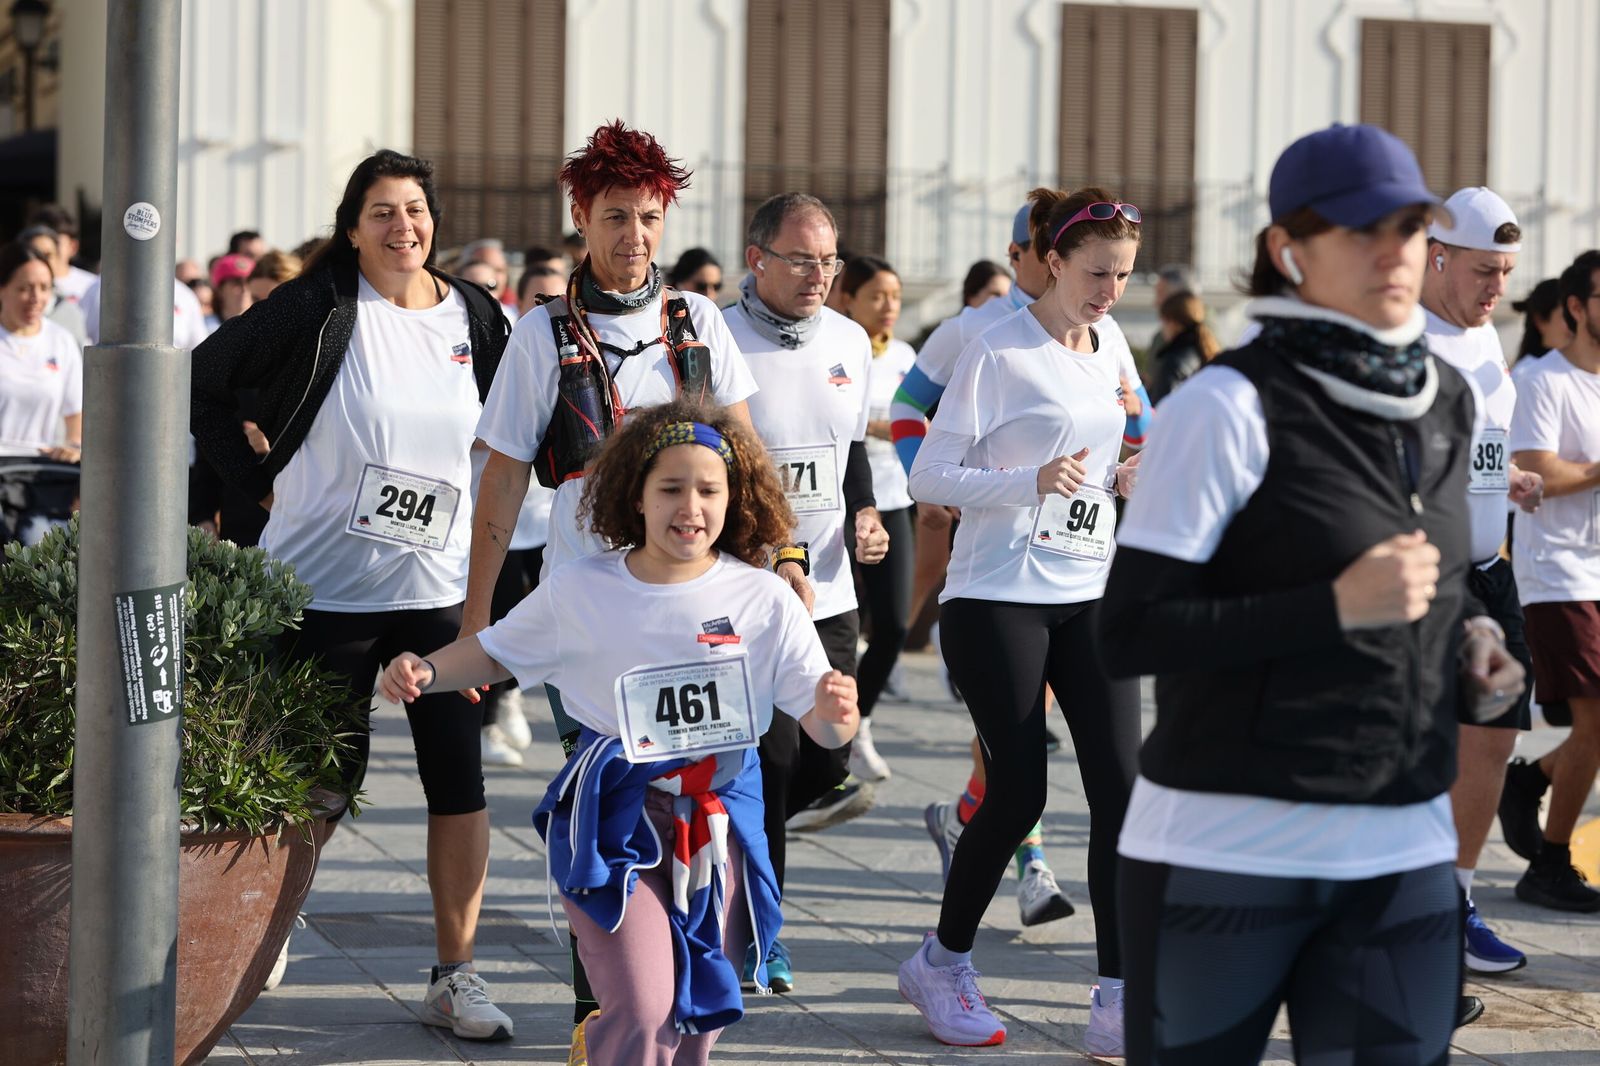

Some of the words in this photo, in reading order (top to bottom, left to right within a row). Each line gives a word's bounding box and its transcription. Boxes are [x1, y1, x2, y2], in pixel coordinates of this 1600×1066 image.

[128, 213, 157, 228] STOMPERS
[136, 209, 153, 219] BLUE
[1473, 443, 1503, 471] 392
[376, 485, 436, 526] 294
[1067, 499, 1100, 535] 94
[116, 597, 121, 605] de
[154, 594, 163, 610] 515
[116, 606, 127, 647] estacionamiento
[146, 613, 156, 632] (34)
[156, 610, 164, 626] 172
[125, 621, 133, 646] contacto
[132, 631, 138, 639] de
[158, 626, 166, 644] 952
[129, 647, 134, 655] en
[133, 639, 142, 668] seguridad
[137, 668, 143, 677] de
[649, 675, 693, 687] INTERNACIONAL
[138, 678, 148, 720] Departamento
[655, 680, 721, 727] 461
[710, 721, 731, 730] PATRICIA
